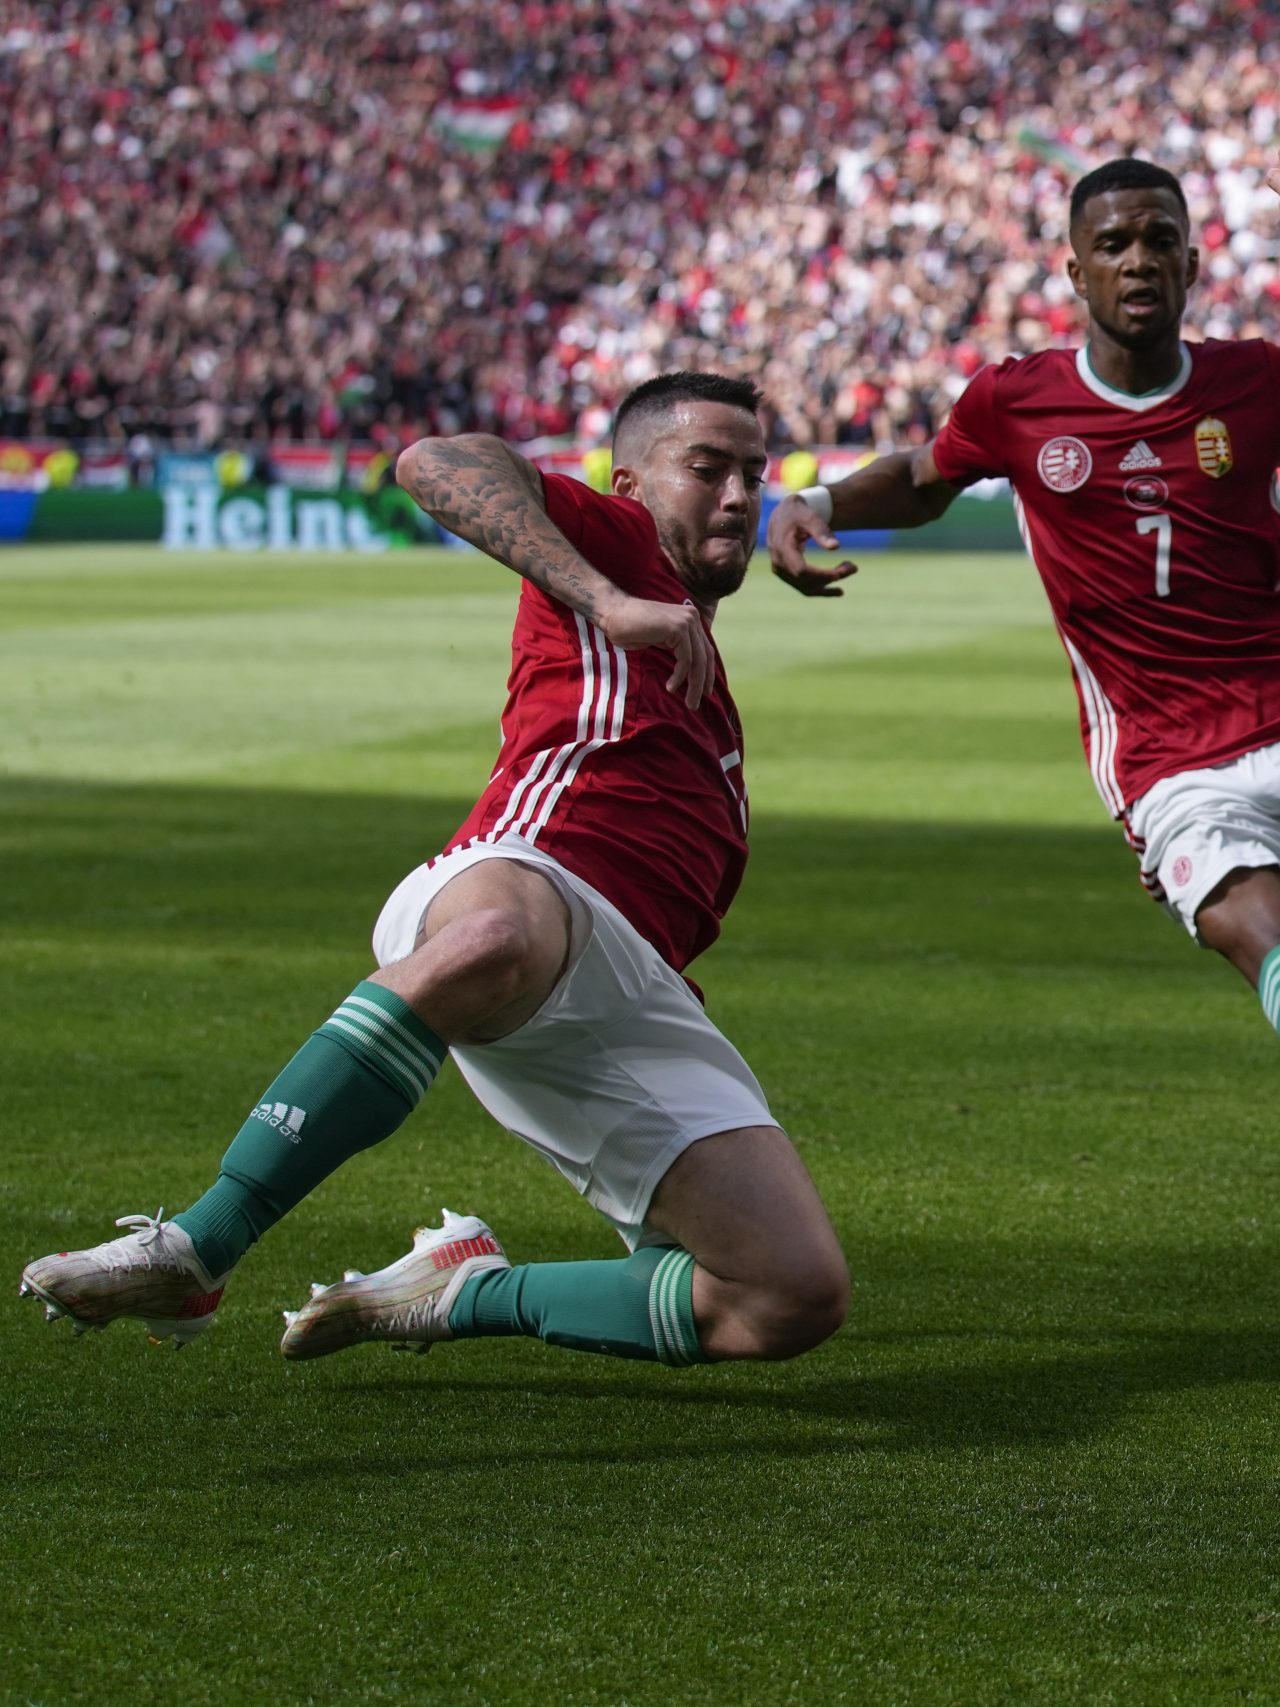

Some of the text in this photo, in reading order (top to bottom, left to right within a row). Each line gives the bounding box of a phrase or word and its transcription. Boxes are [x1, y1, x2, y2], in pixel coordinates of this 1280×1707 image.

[1118, 457, 1162, 471] adidas
[1135, 513, 1172, 598] 7
[250, 1108, 302, 1144] adidas
